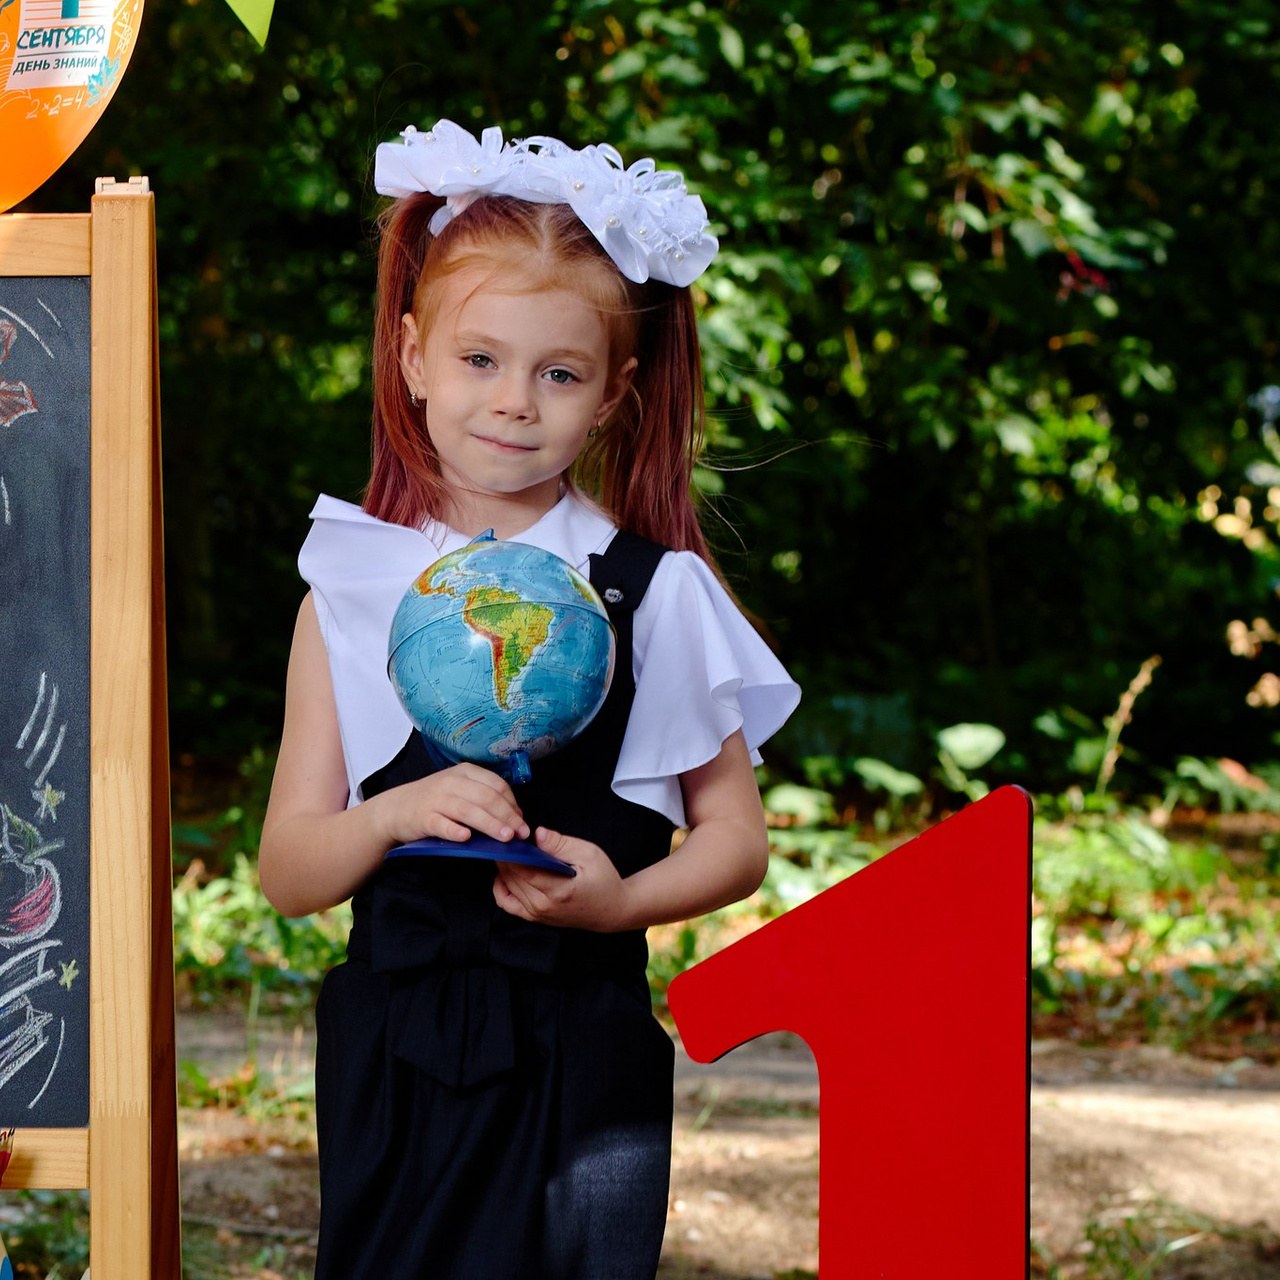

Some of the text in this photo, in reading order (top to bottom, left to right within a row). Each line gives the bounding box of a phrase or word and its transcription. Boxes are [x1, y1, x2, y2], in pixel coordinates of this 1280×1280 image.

[17, 25, 105, 49] СЕНТЯБРЯ
[13, 56, 97, 75] ДЕНЬ ЗНАНИЙ
